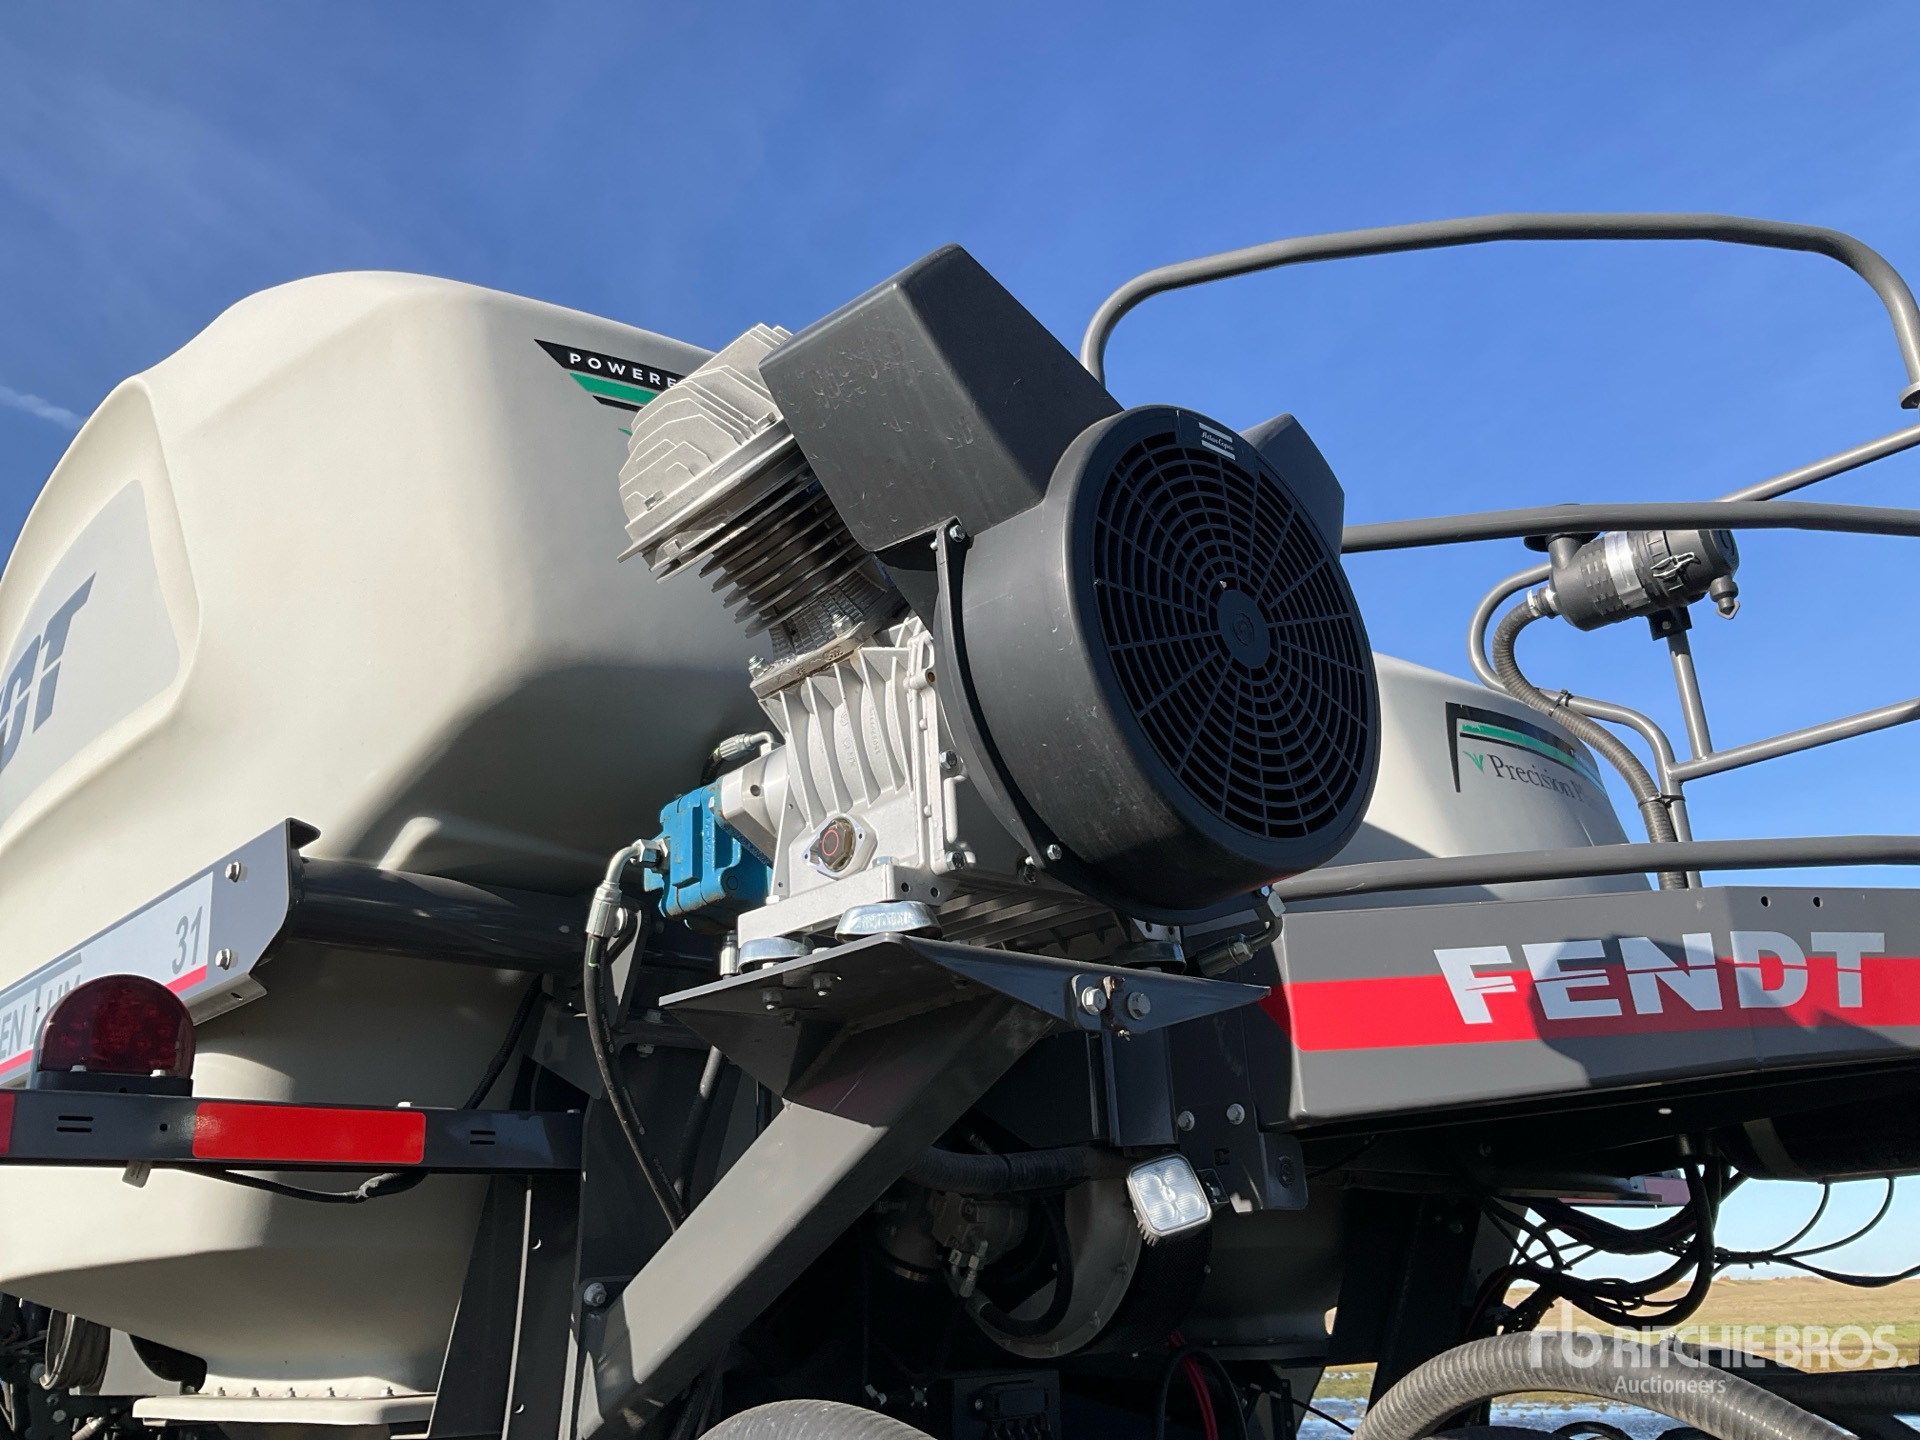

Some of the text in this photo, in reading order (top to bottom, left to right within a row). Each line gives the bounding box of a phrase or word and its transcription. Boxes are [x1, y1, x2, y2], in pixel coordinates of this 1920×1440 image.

[1487, 753, 1577, 799] Precision
[171, 905, 203, 975] 31
[1433, 930, 1886, 1025] FENDT
